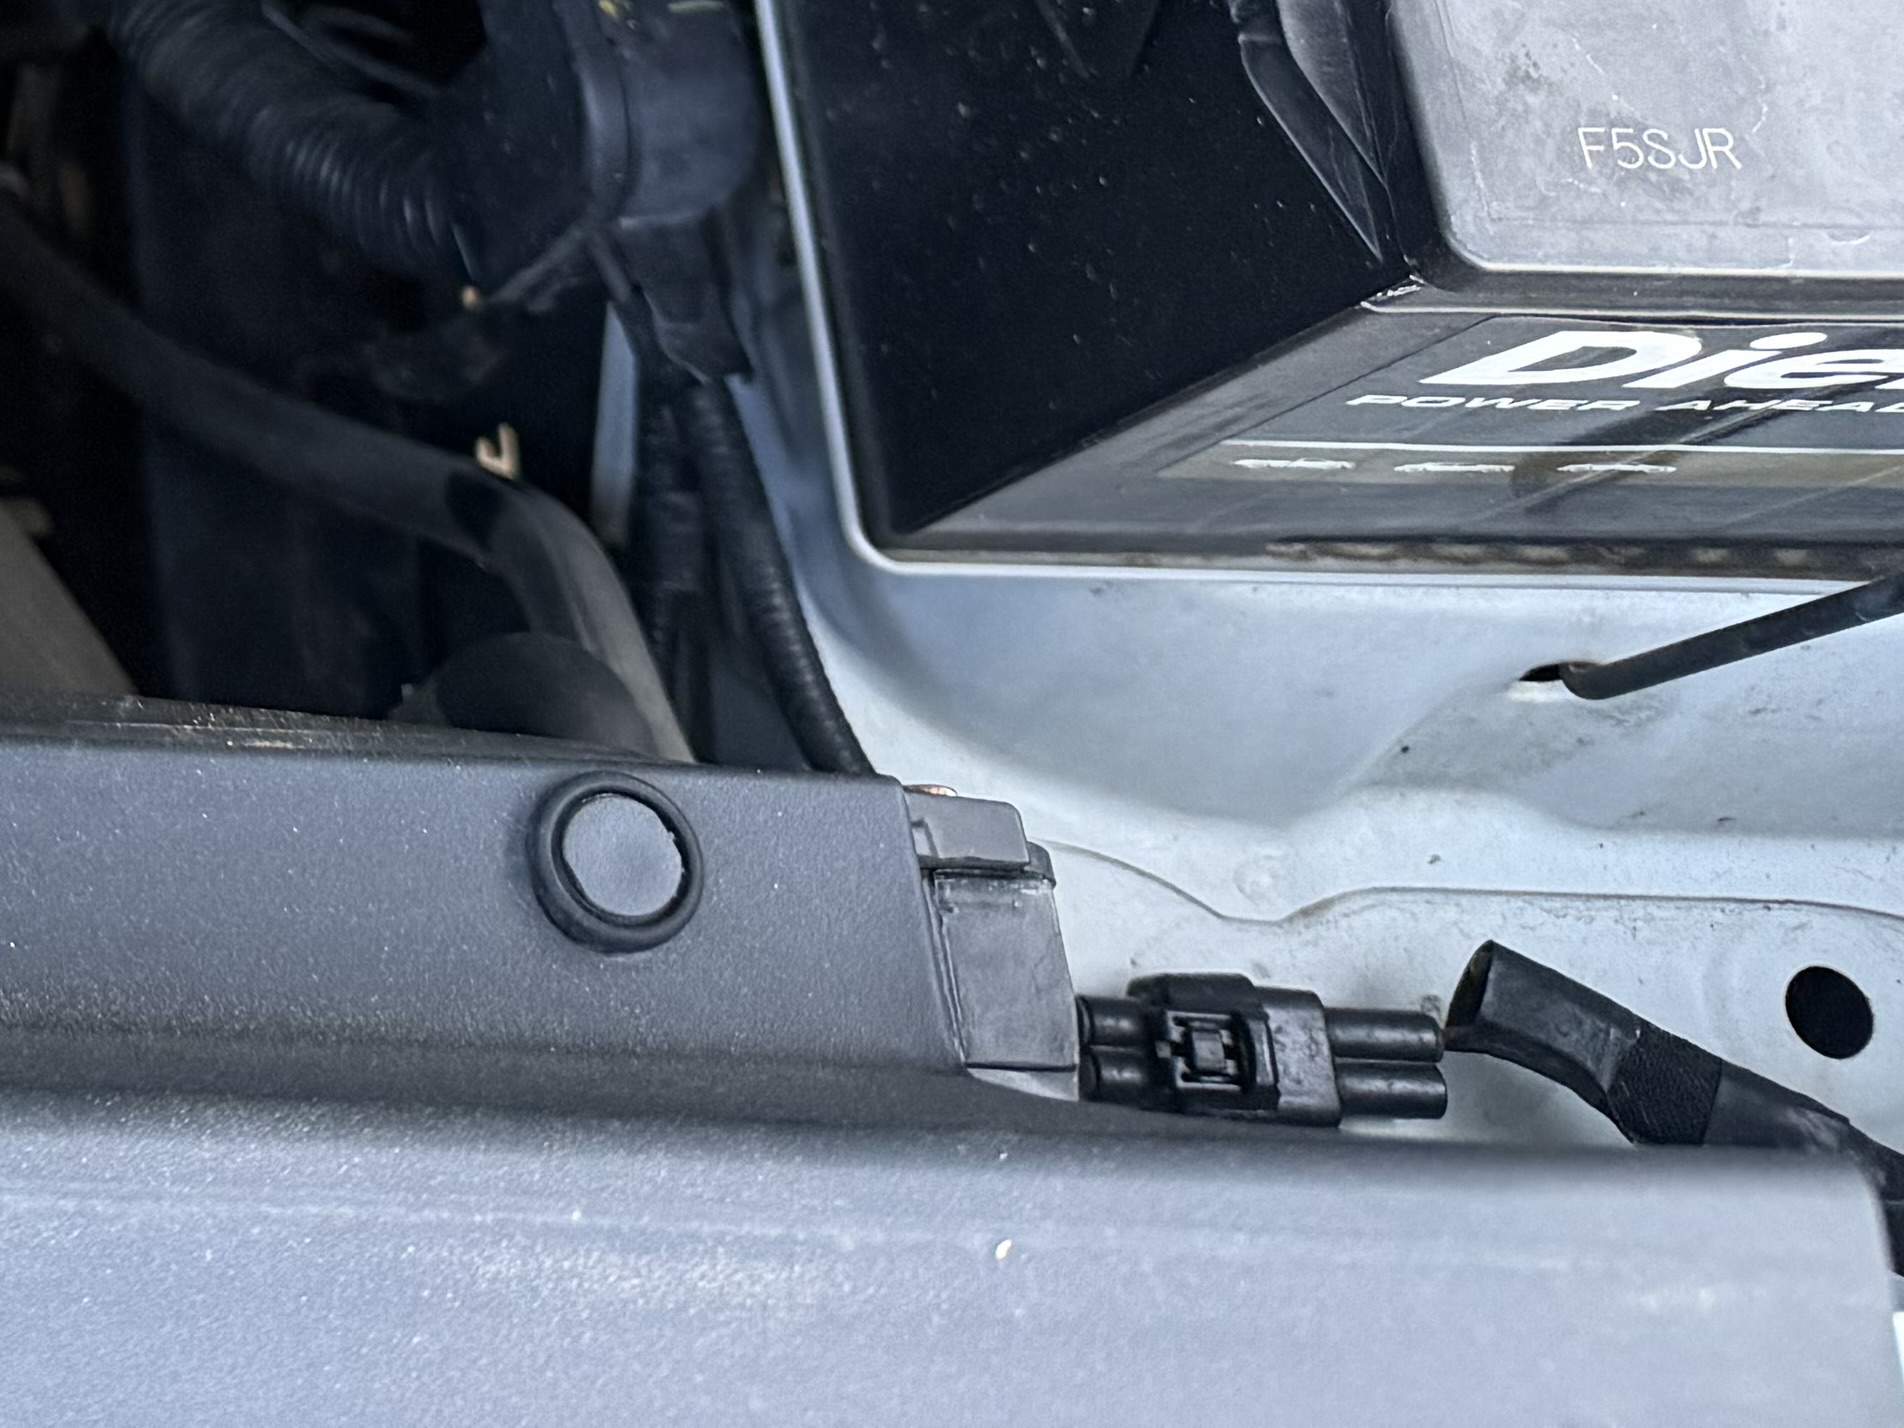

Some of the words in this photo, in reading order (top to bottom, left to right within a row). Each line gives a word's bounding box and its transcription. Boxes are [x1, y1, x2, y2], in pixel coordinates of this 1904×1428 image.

[1577, 127, 1743, 170] F5SJR
[1417, 330, 1904, 390] Die
[1346, 394, 1641, 412] POWER
